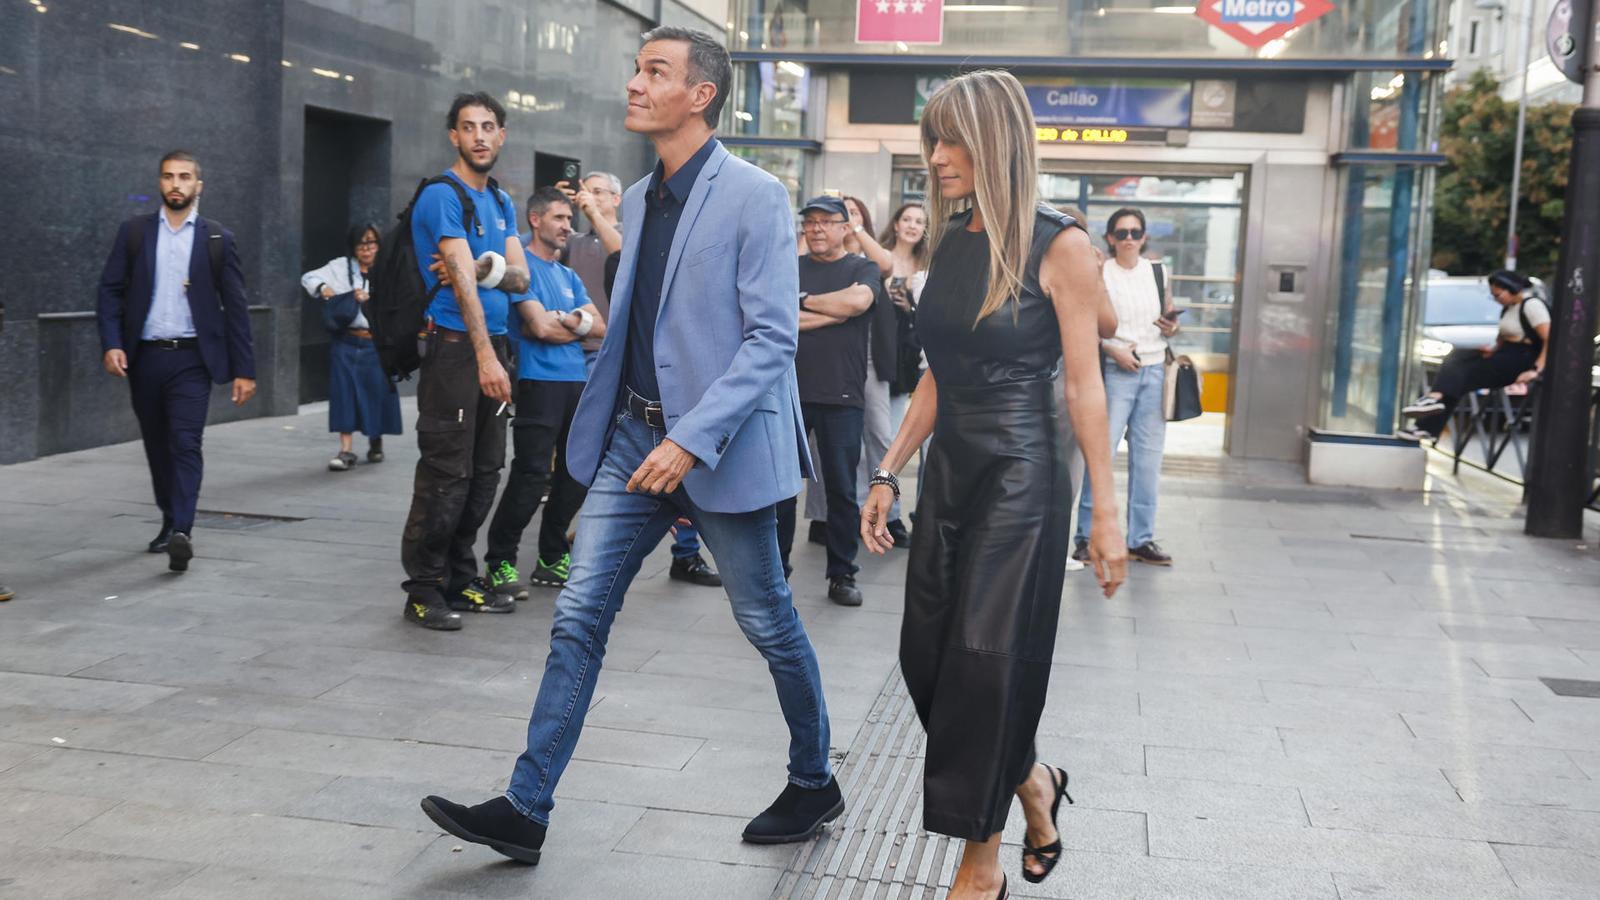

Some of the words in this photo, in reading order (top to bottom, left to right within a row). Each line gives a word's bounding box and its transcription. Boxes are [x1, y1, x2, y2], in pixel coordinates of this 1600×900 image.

[1224, 0, 1291, 17] Metro
[1046, 90, 1099, 107] Callao
[1061, 129, 1078, 141] de
[1081, 129, 1128, 142] CALLAO
